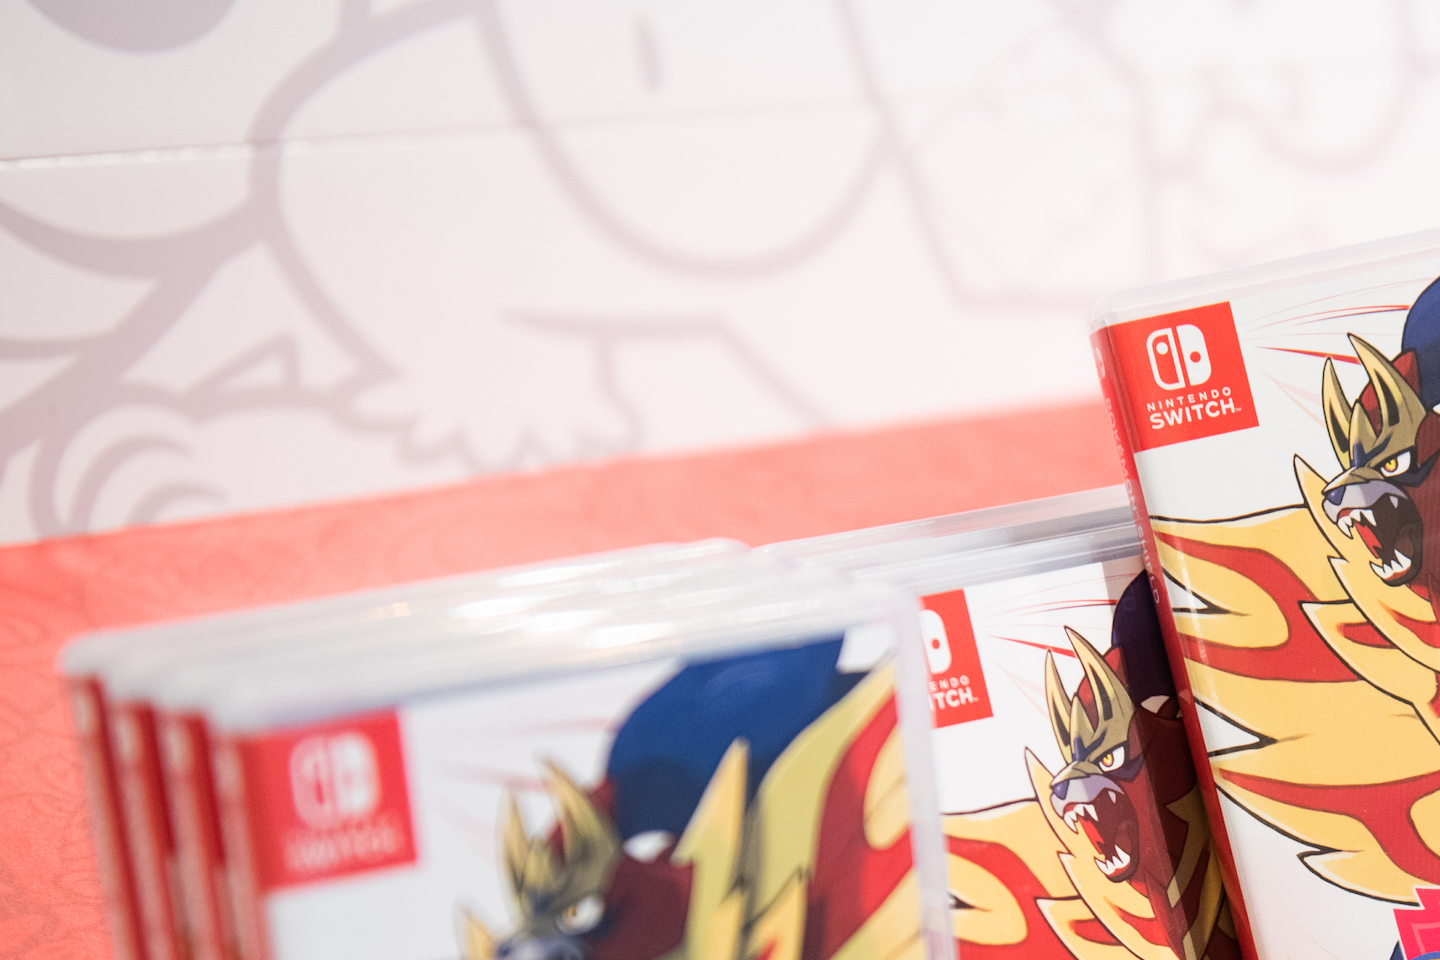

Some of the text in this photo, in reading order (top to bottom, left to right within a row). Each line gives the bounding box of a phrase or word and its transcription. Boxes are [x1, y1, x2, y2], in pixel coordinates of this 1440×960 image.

[1146, 386, 1232, 412] NINTENDO
[1149, 397, 1236, 430] SWITCH
[928, 686, 975, 711] ITCH
